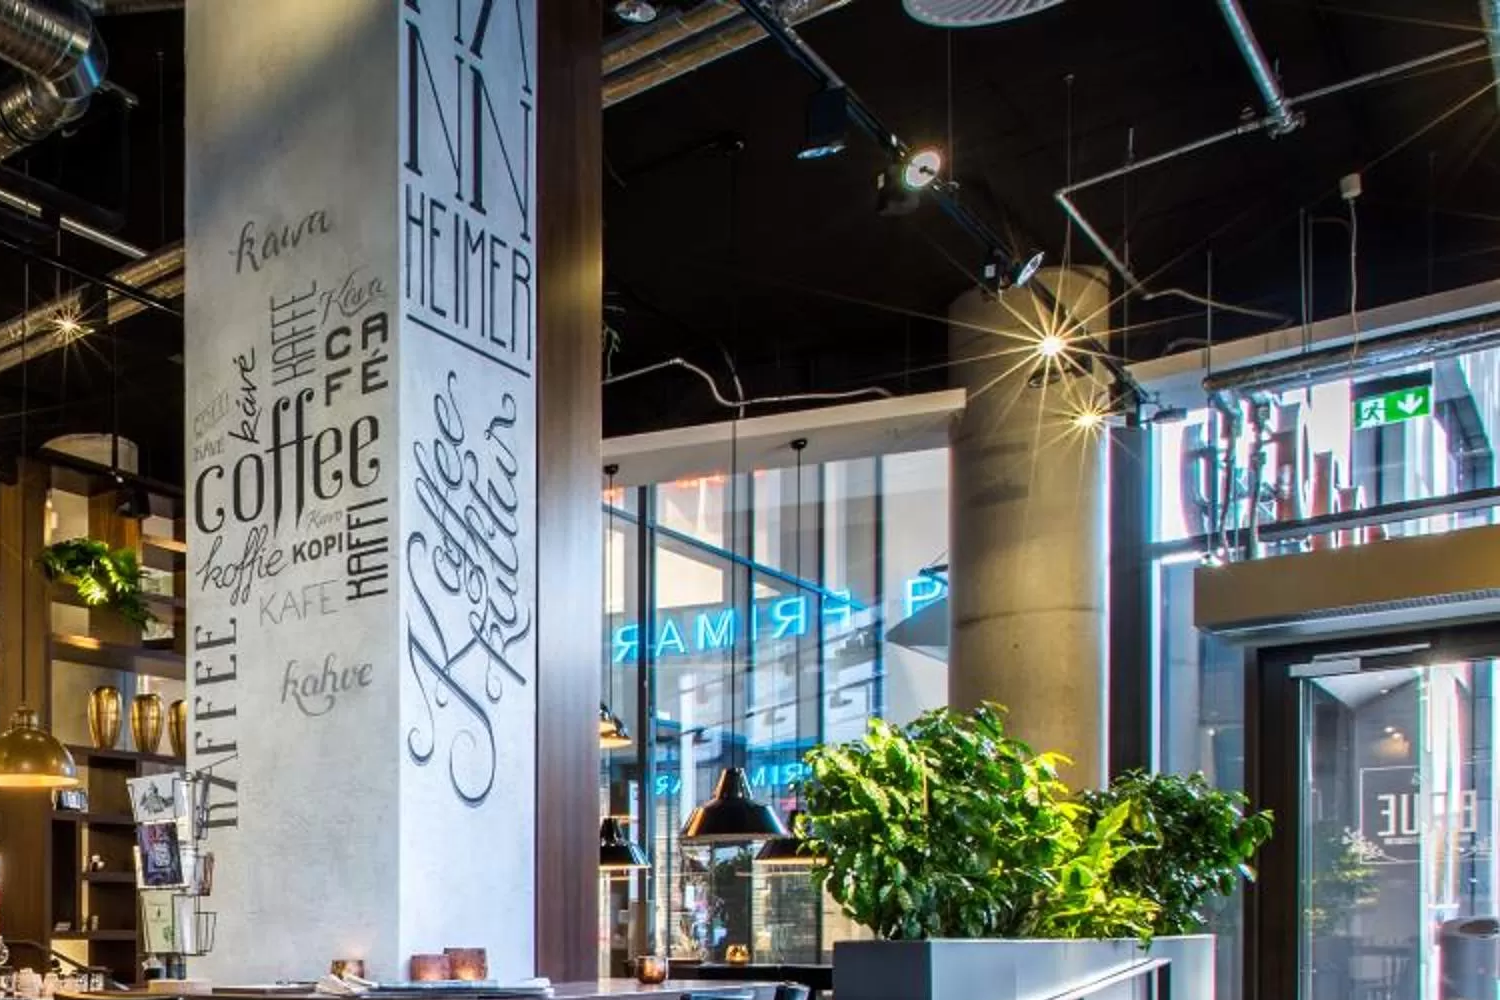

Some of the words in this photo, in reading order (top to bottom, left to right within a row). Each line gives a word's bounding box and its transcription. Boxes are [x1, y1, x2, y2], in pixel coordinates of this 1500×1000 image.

[229, 209, 332, 274] kawa
[405, 183, 532, 360] HEIMER
[194, 387, 379, 540] coffee
[196, 524, 289, 606] koffie
[292, 532, 343, 564] KOPI
[259, 578, 339, 628] KAFE
[281, 652, 374, 716] kahve
